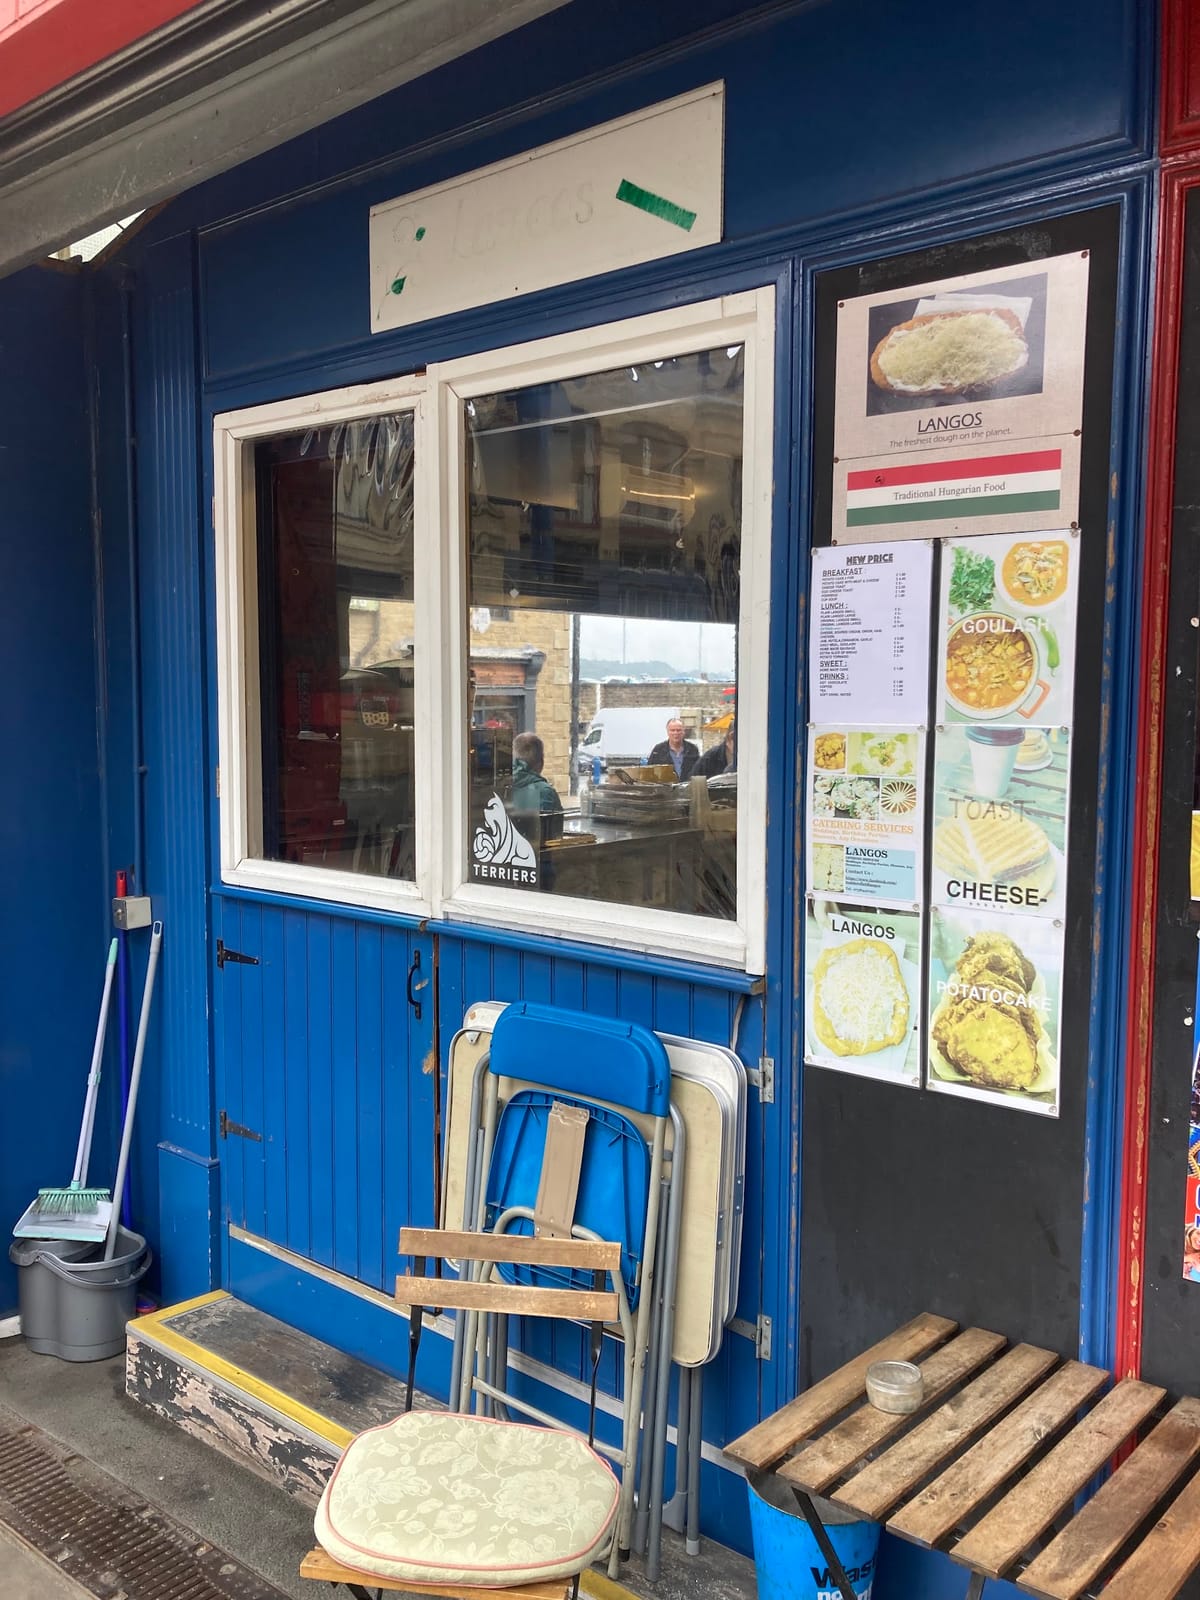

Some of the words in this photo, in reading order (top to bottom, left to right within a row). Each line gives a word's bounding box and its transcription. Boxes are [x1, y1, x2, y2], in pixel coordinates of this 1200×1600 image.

[918, 412, 983, 433] LANGOS
[889, 439, 904, 449] The
[904, 436, 932, 448] freshest
[933, 432, 959, 445] dough
[960, 432, 971, 441] on
[972, 428, 985, 440] the
[893, 487, 937, 501] Traditional
[938, 484, 981, 498] Hungarian
[983, 481, 1006, 493] Food
[846, 554, 866, 567] NEW
[867, 553, 893, 565] PRICE
[822, 567, 863, 578] BREAKFAST
[962, 617, 1050, 635] GOULASH
[948, 796, 1036, 823] TOAST
[812, 819, 861, 830] CATERING
[863, 822, 913, 833] SERVICES
[846, 847, 888, 859] LANGOS
[473, 864, 537, 883] TERRIERS
[832, 920, 896, 940] LANGOS
[936, 980, 1053, 1011] POTATOCAKE
